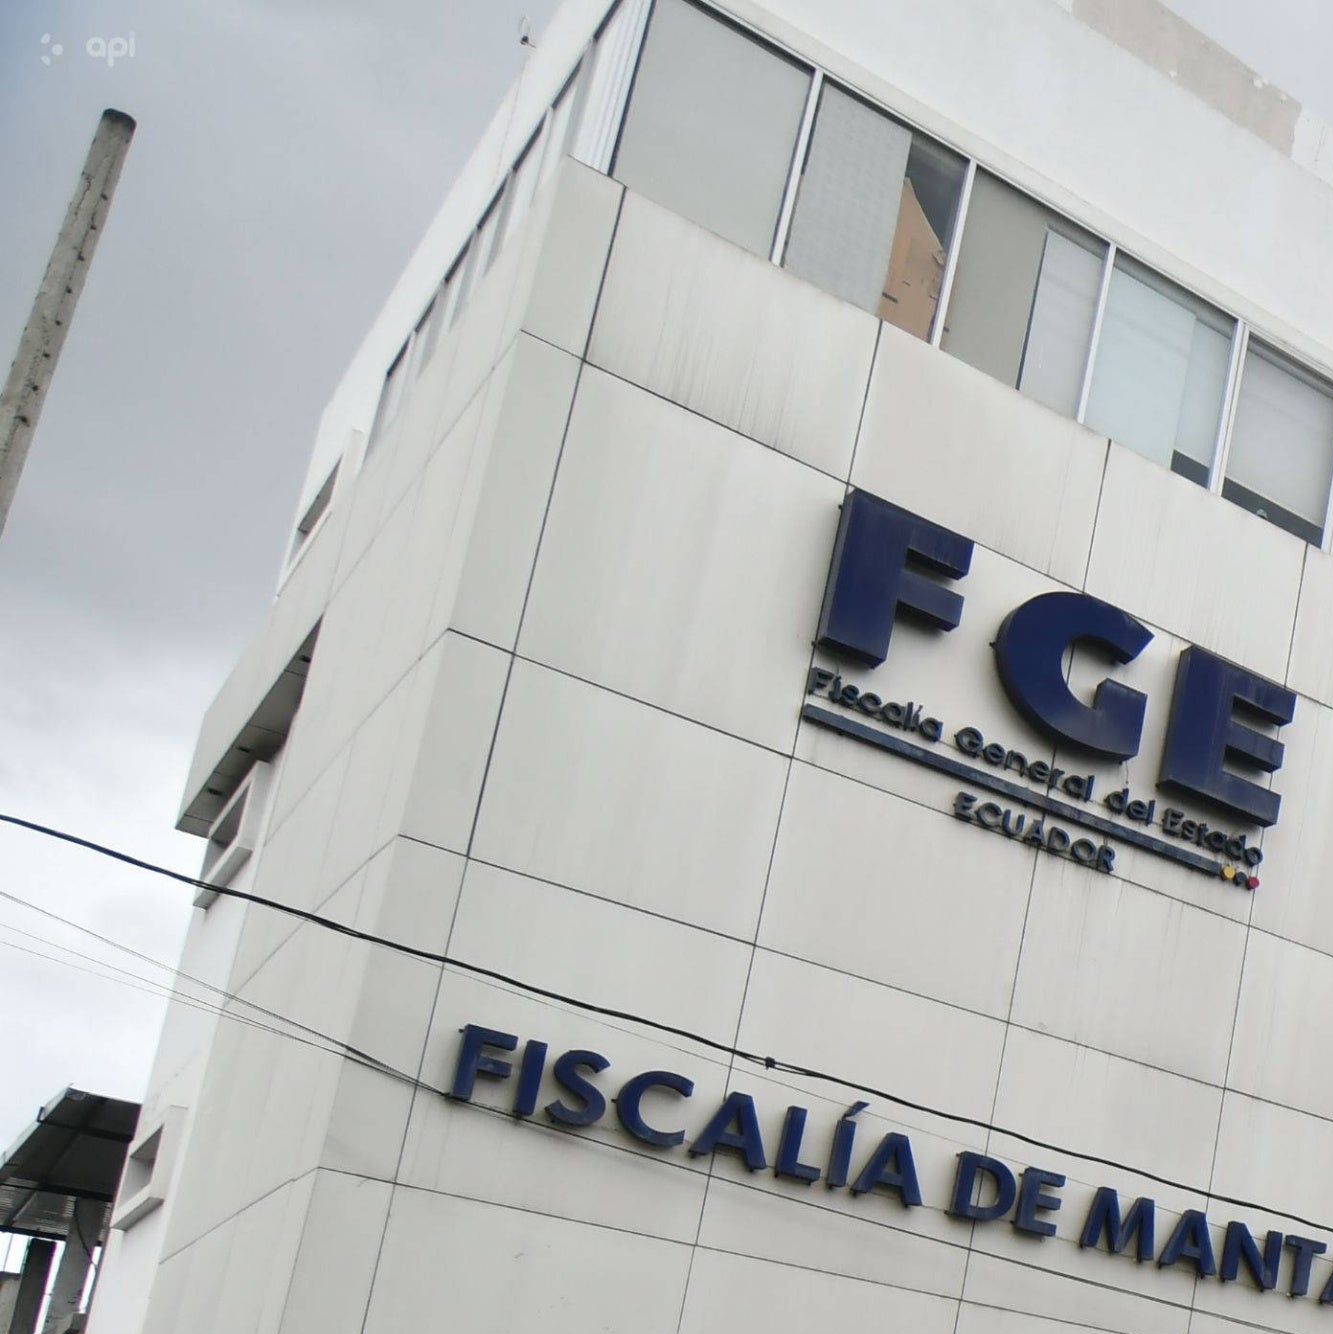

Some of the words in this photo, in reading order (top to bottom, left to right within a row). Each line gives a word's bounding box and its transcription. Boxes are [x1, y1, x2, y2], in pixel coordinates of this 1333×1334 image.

[817, 487, 1298, 829] FGE
[808, 666, 943, 742] Fiscalía
[954, 727, 1094, 802] General
[1105, 787, 1155, 826] del
[1163, 807, 1263, 868] Estado
[953, 791, 1115, 873] ECUADOR
[448, 1024, 922, 1208] FISCALÍA
[945, 1150, 1067, 1238] DE
